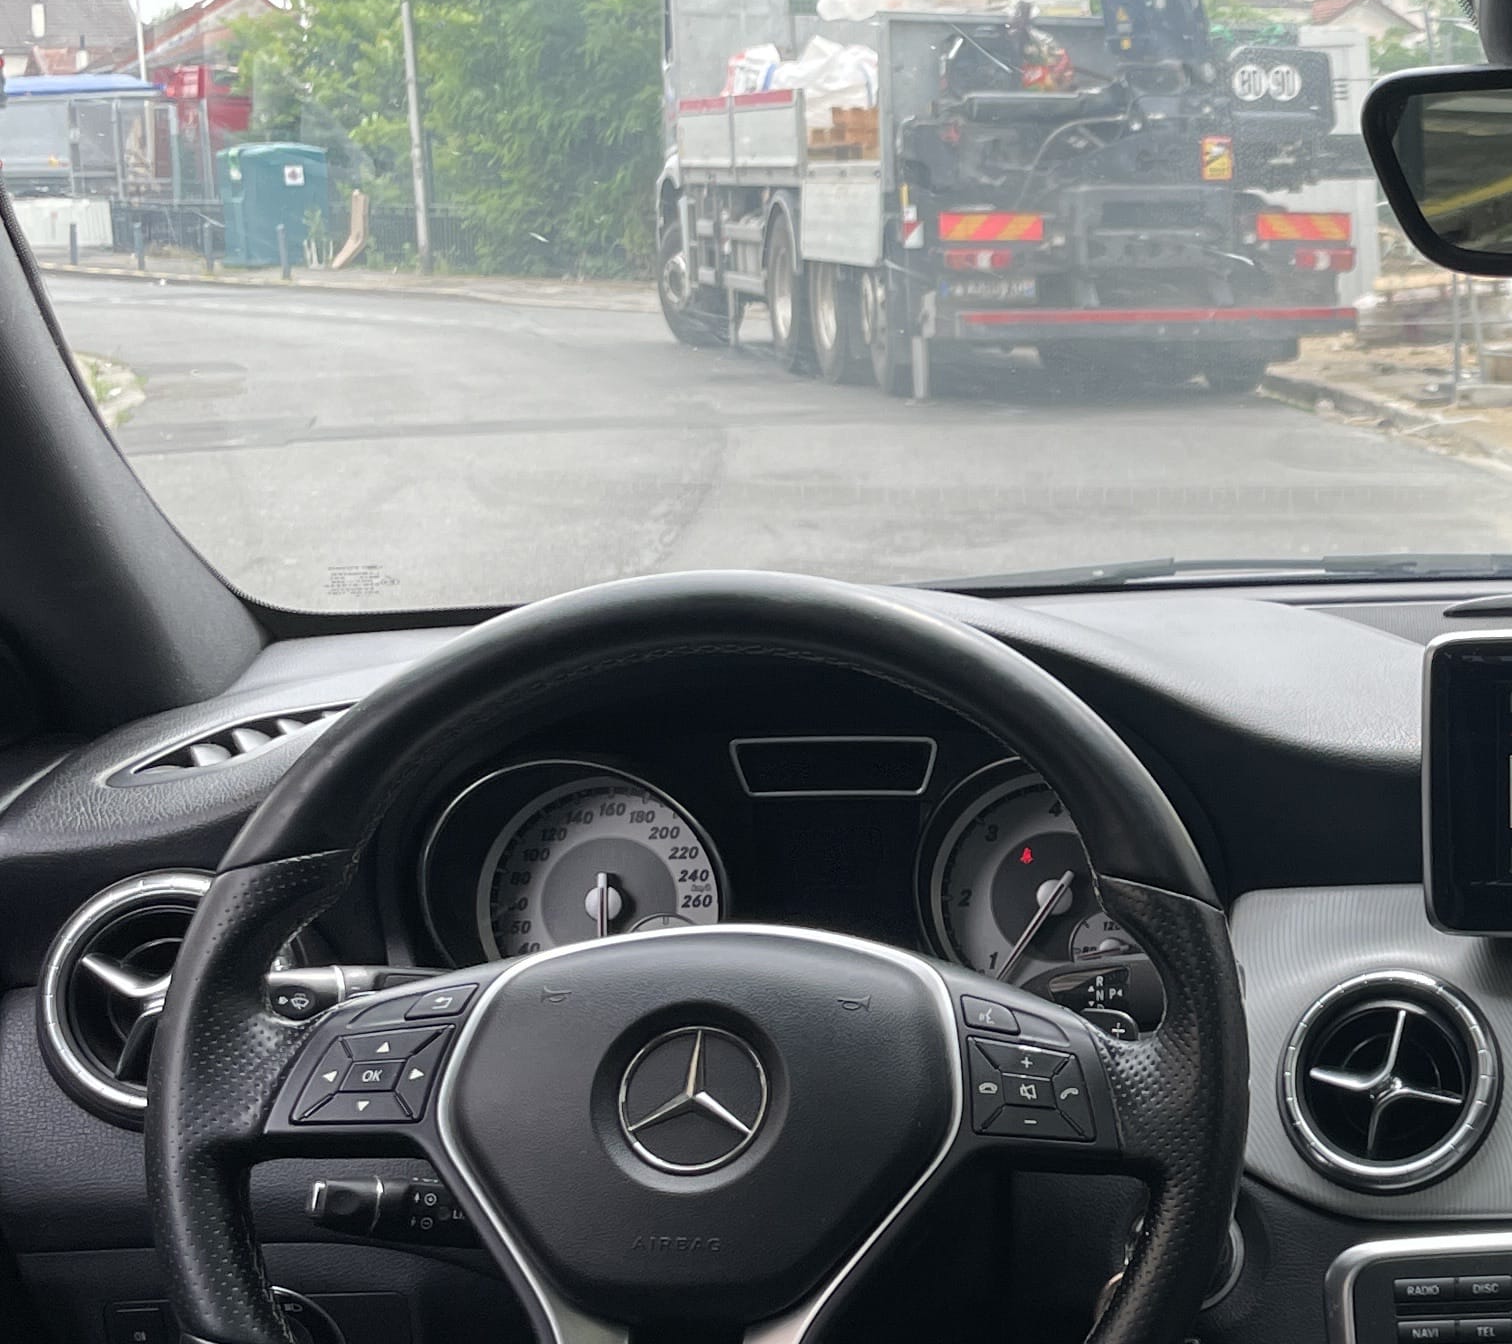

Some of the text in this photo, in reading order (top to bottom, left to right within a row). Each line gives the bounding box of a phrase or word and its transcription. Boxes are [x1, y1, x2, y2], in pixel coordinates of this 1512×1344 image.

[599, 802, 626, 817] 160
[566, 811, 594, 825] 140
[629, 810, 656, 824] 180
[648, 826, 680, 840] 200
[984, 824, 999, 843] 3
[668, 846, 699, 860] 220
[678, 869, 709, 883] 240
[681, 894, 713, 909] 260
[957, 888, 973, 907] 2
[510, 919, 531, 934] 50
[518, 942, 541, 955] 40
[988, 951, 999, 970] 1
[1096, 975, 1104, 987] R
[1096, 989, 1104, 1001] N
[1108, 987, 1117, 1000] P
[361, 1069, 383, 1083] OK
[631, 1235, 721, 1253] AIRBAG
[1406, 1284, 1440, 1296] RADIO
[1472, 1282, 1499, 1294] DISC
[1411, 1327, 1440, 1338] NAVI
[1476, 1326, 1496, 1337] TEL
